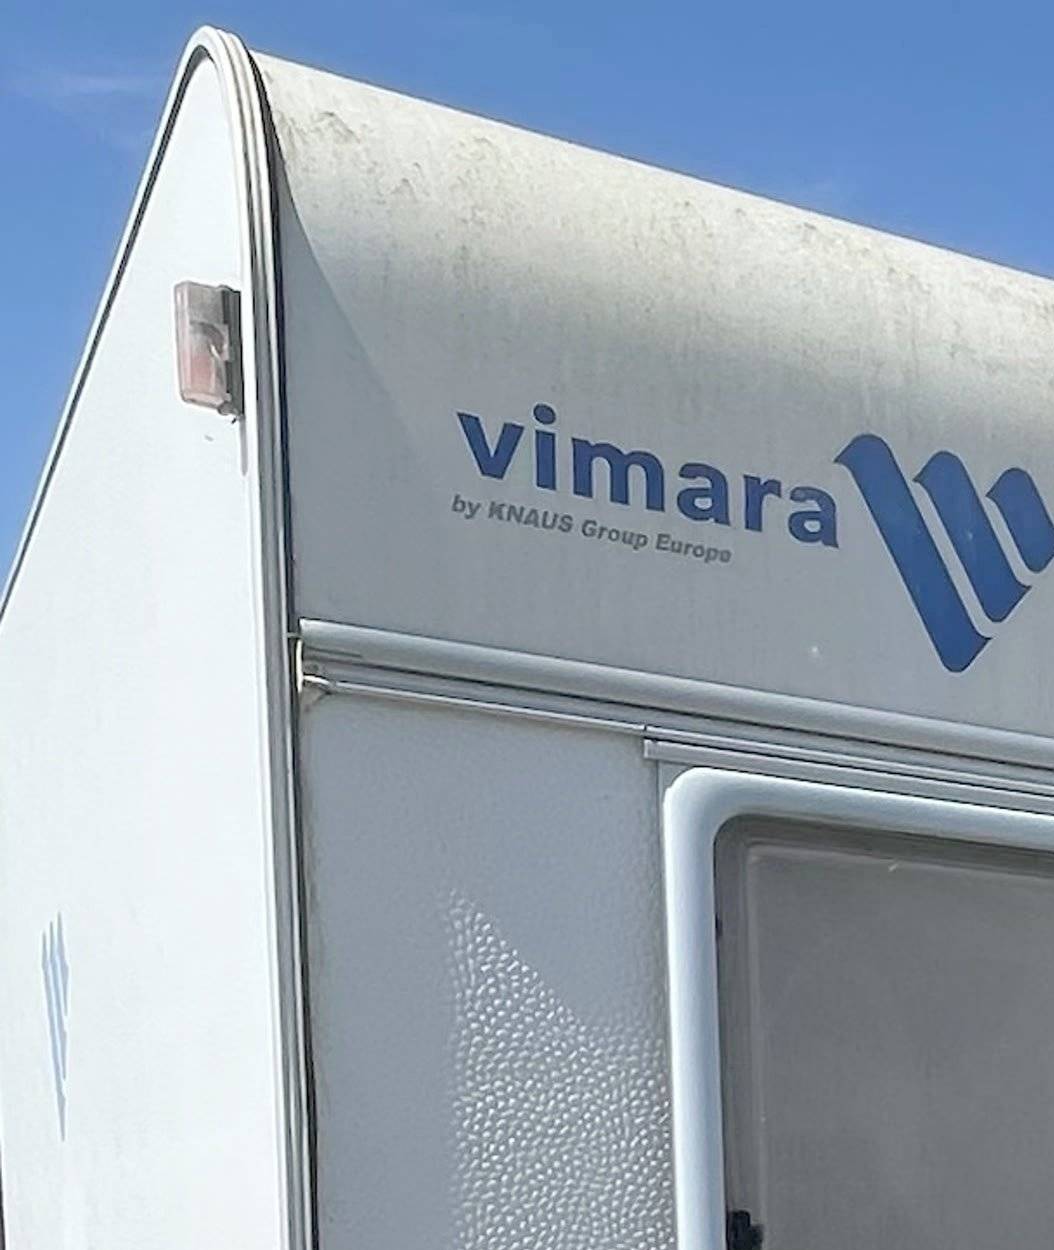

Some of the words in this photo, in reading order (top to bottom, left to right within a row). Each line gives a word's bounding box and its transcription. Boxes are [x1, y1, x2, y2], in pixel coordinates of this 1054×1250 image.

[451, 494, 482, 519] by
[488, 501, 574, 533] KNAUS
[581, 519, 649, 550] Group
[655, 533, 733, 564] Europe
[457, 403, 840, 549] vimara
